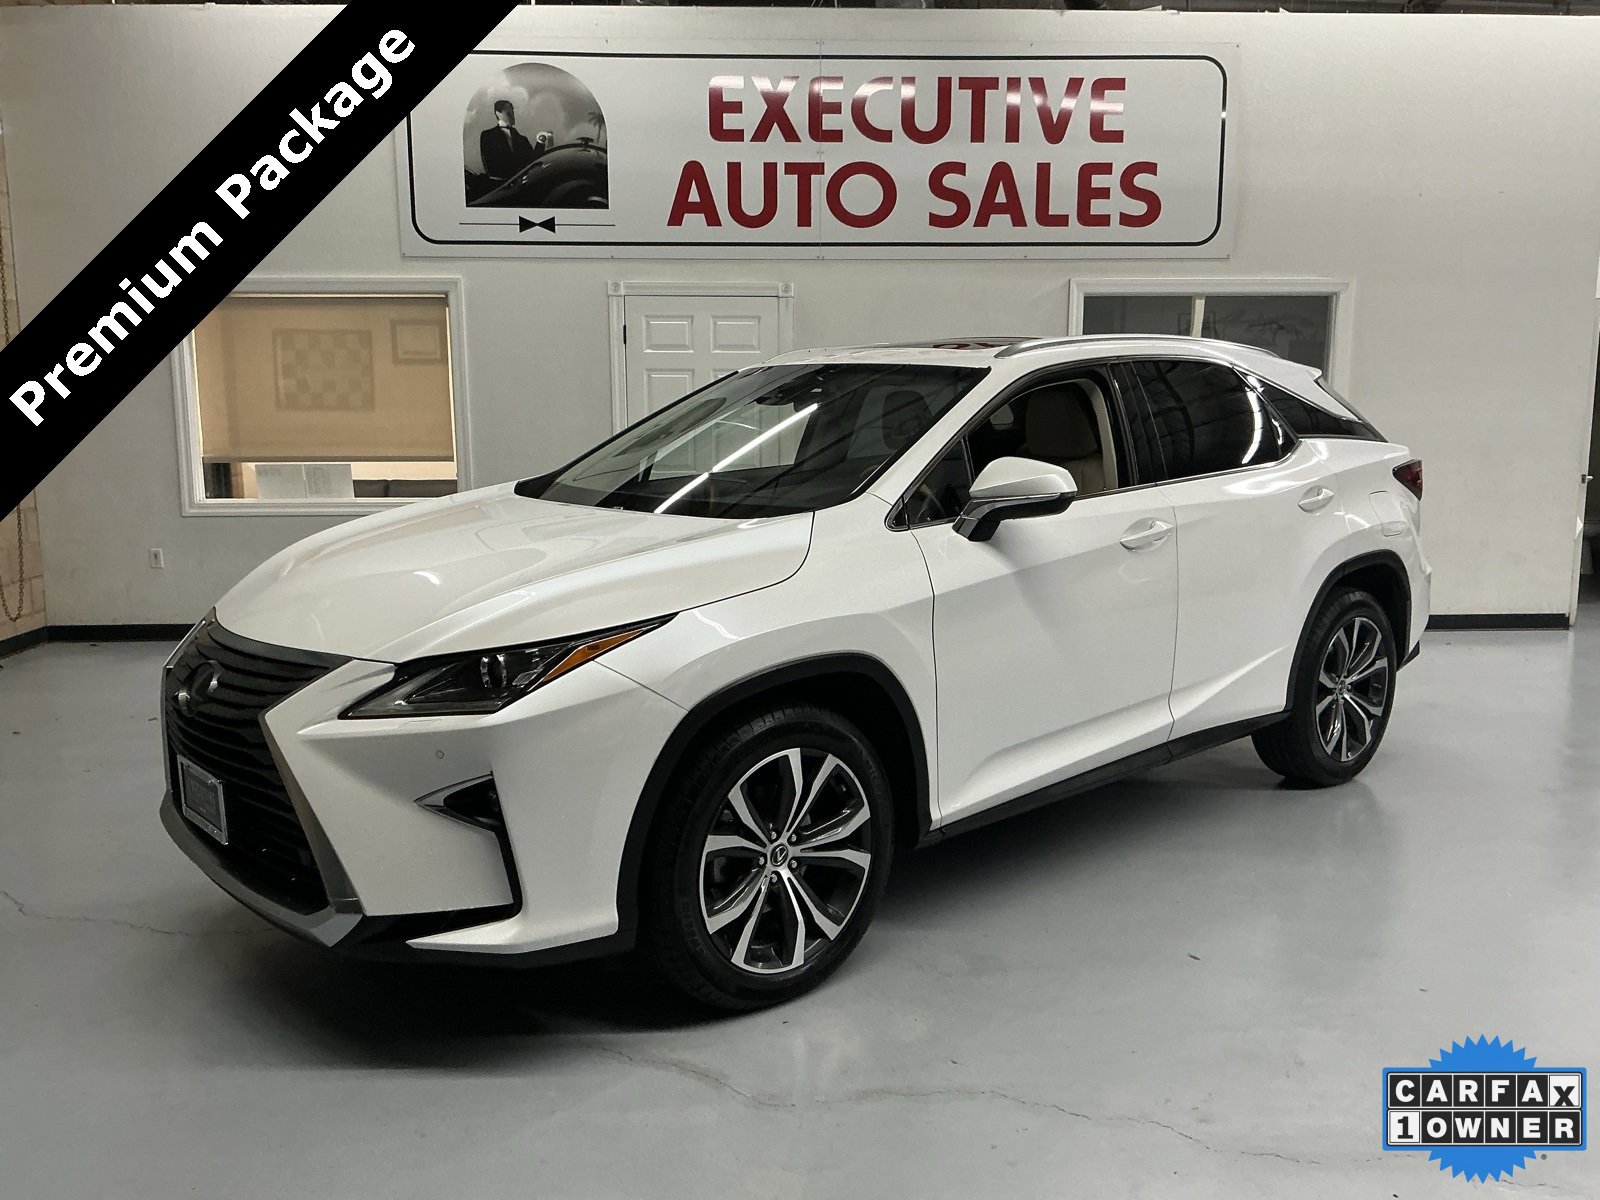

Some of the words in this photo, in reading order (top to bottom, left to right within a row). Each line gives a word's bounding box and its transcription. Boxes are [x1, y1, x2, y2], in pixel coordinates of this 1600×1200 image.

[709, 75, 1126, 145] EXECUTIVE
[667, 160, 897, 229] AUTO
[928, 160, 1162, 229] SALES
